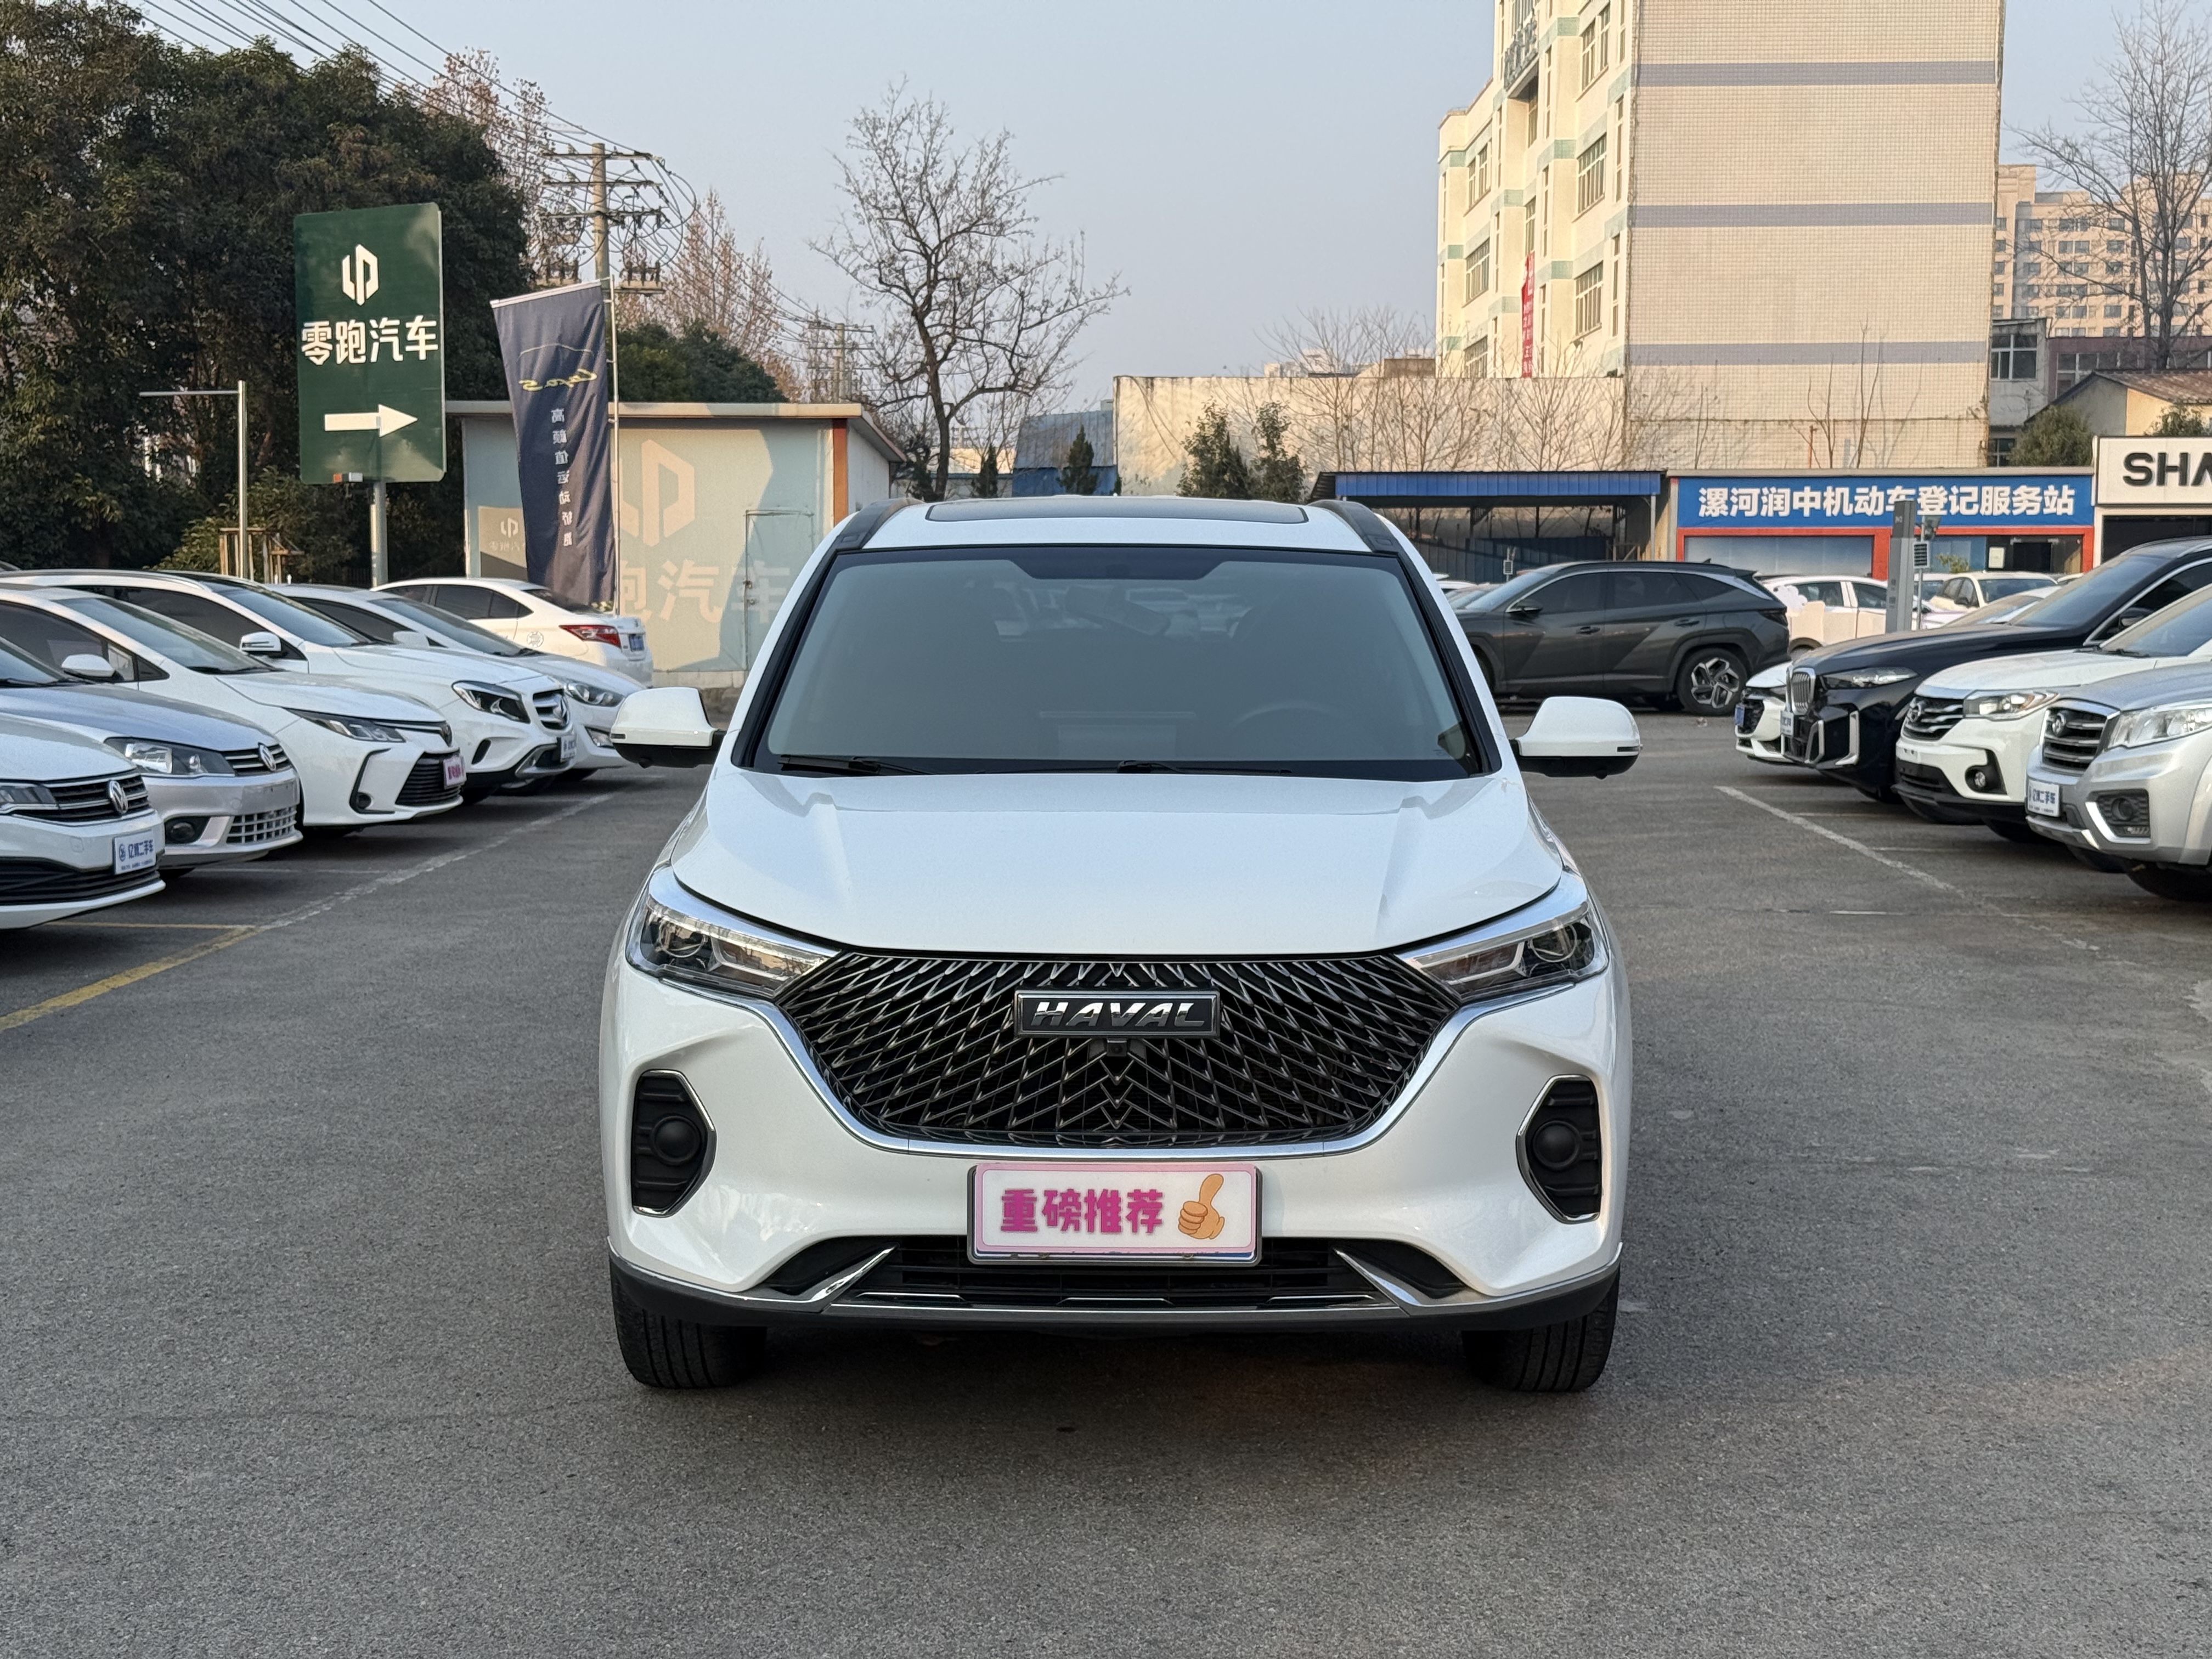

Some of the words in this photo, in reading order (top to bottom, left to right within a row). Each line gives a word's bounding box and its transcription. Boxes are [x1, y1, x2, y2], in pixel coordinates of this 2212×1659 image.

[301, 315, 438, 365] 零跑汽车
[1031, 1001, 1207, 1028] HAVAL
[1000, 1187, 1164, 1234] 重磅推荐
